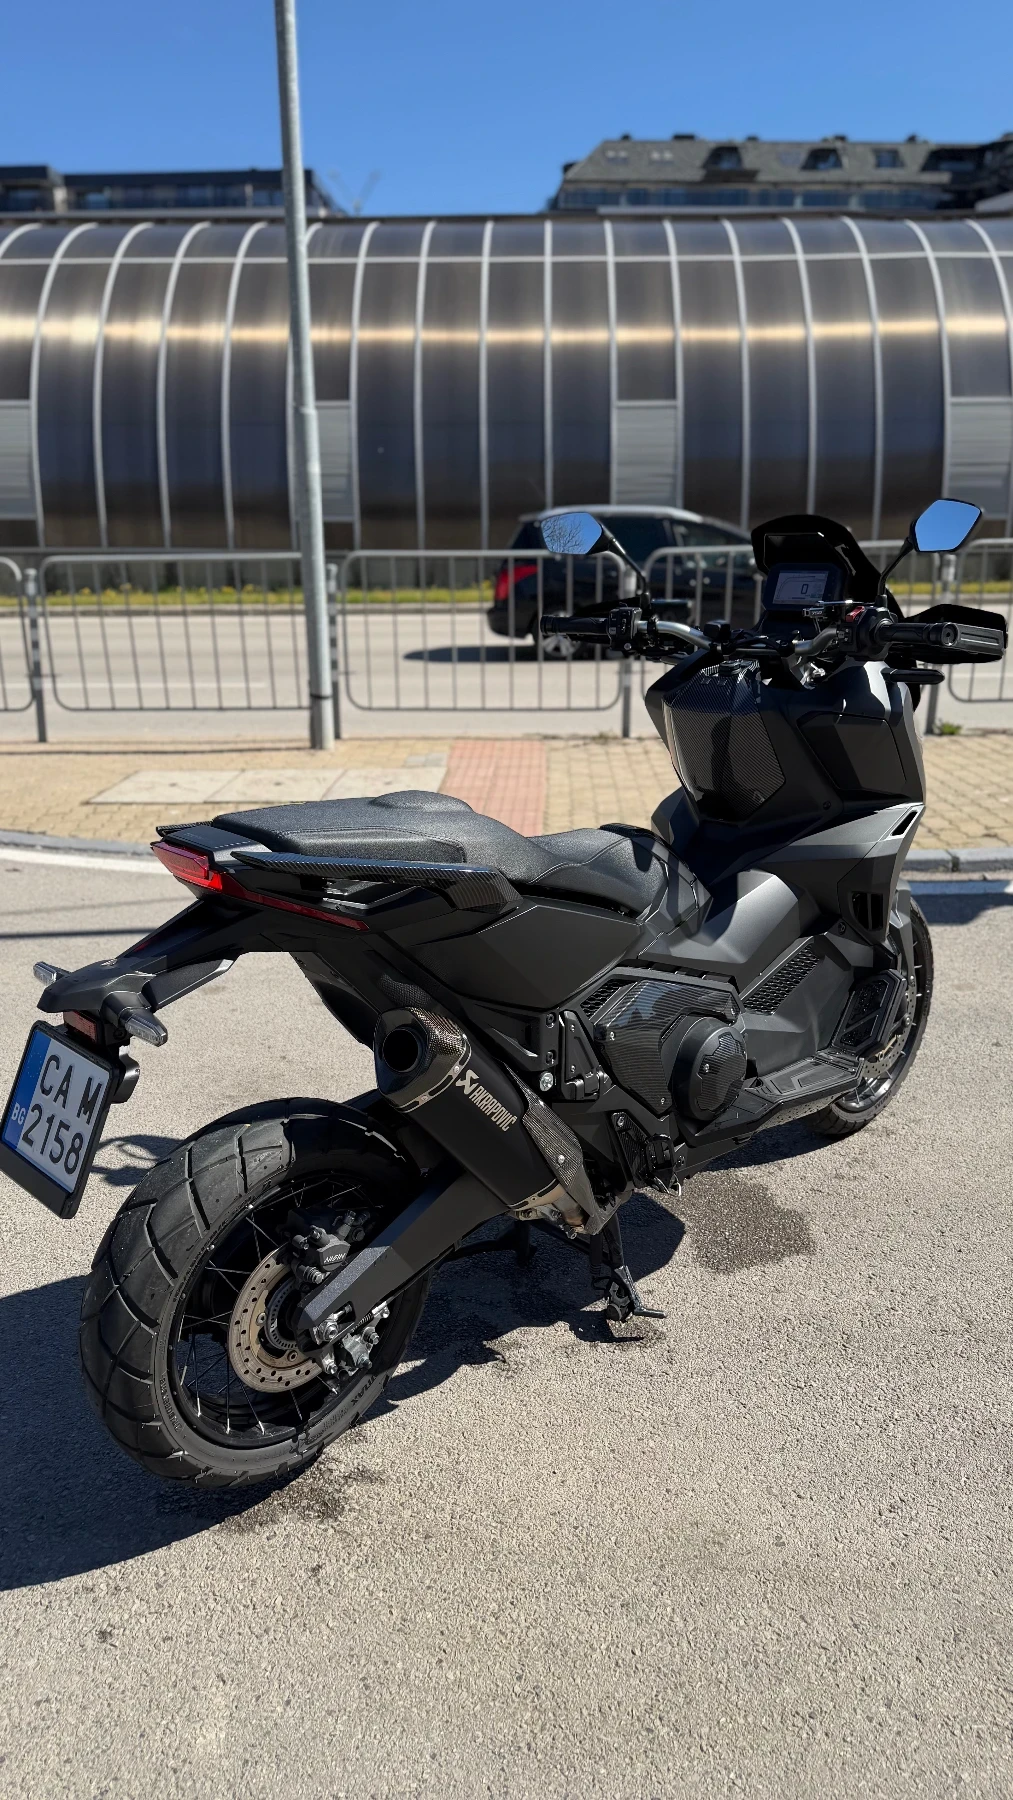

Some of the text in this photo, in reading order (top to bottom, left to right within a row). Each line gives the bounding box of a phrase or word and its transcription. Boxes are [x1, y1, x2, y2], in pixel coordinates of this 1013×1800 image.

[801, 583, 809, 595] 0
[40, 1054, 102, 1125] CA M
[11, 1103, 26, 1125] BG
[22, 1104, 84, 1175] 2158
